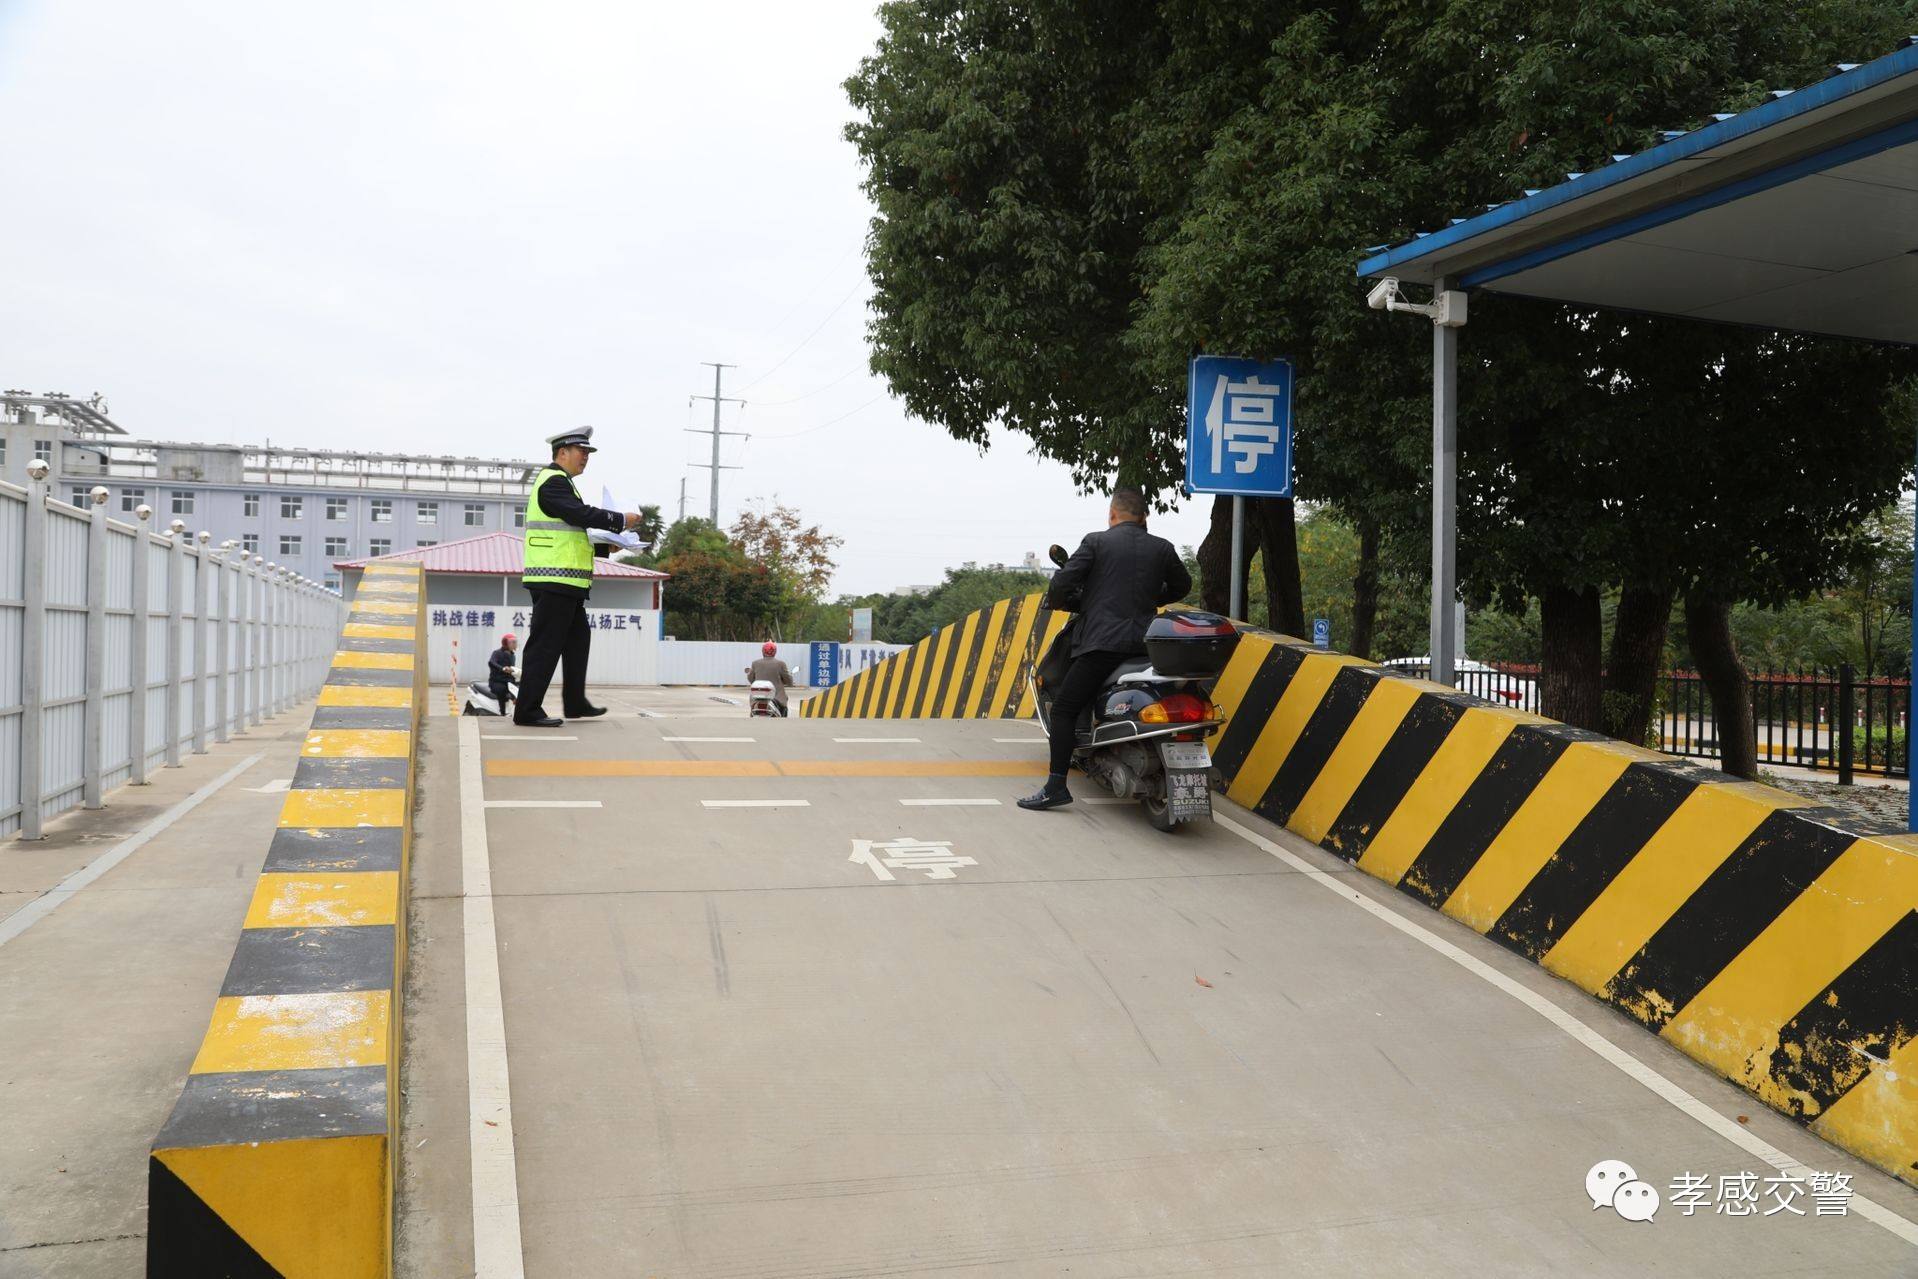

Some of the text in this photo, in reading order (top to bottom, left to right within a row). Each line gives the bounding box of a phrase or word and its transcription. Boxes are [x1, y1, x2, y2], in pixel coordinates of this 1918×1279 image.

[1205, 374, 1280, 473] 停
[432, 610, 495, 627] 挑战佳绩
[512, 612, 531, 627] 公
[818, 643, 830, 686] 通过单边桥
[848, 837, 979, 880] 停
